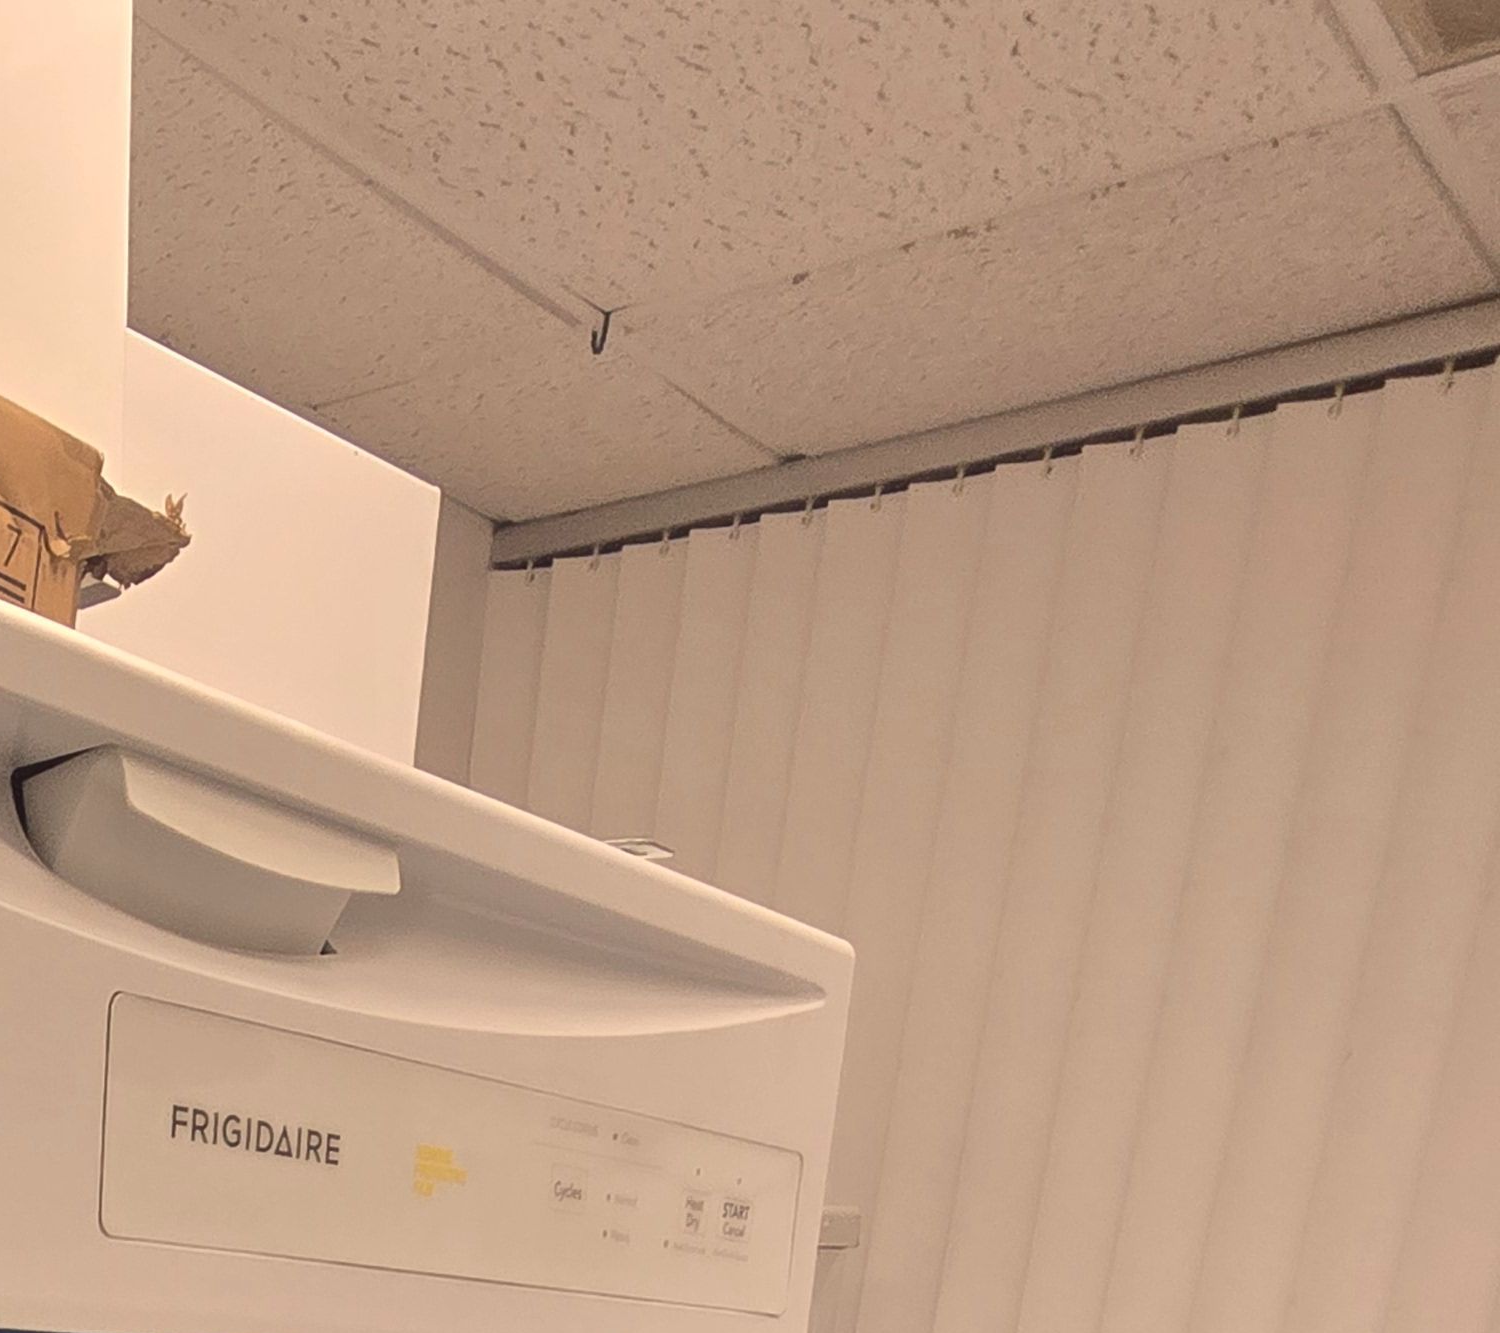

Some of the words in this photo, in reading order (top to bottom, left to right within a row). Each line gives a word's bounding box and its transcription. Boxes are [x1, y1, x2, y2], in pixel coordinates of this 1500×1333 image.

[171, 1104, 341, 1166] FRIGIDAIRE
[554, 1180, 582, 1201] Cycles
[722, 1202, 750, 1221] START
[686, 1213, 700, 1232] Dry
